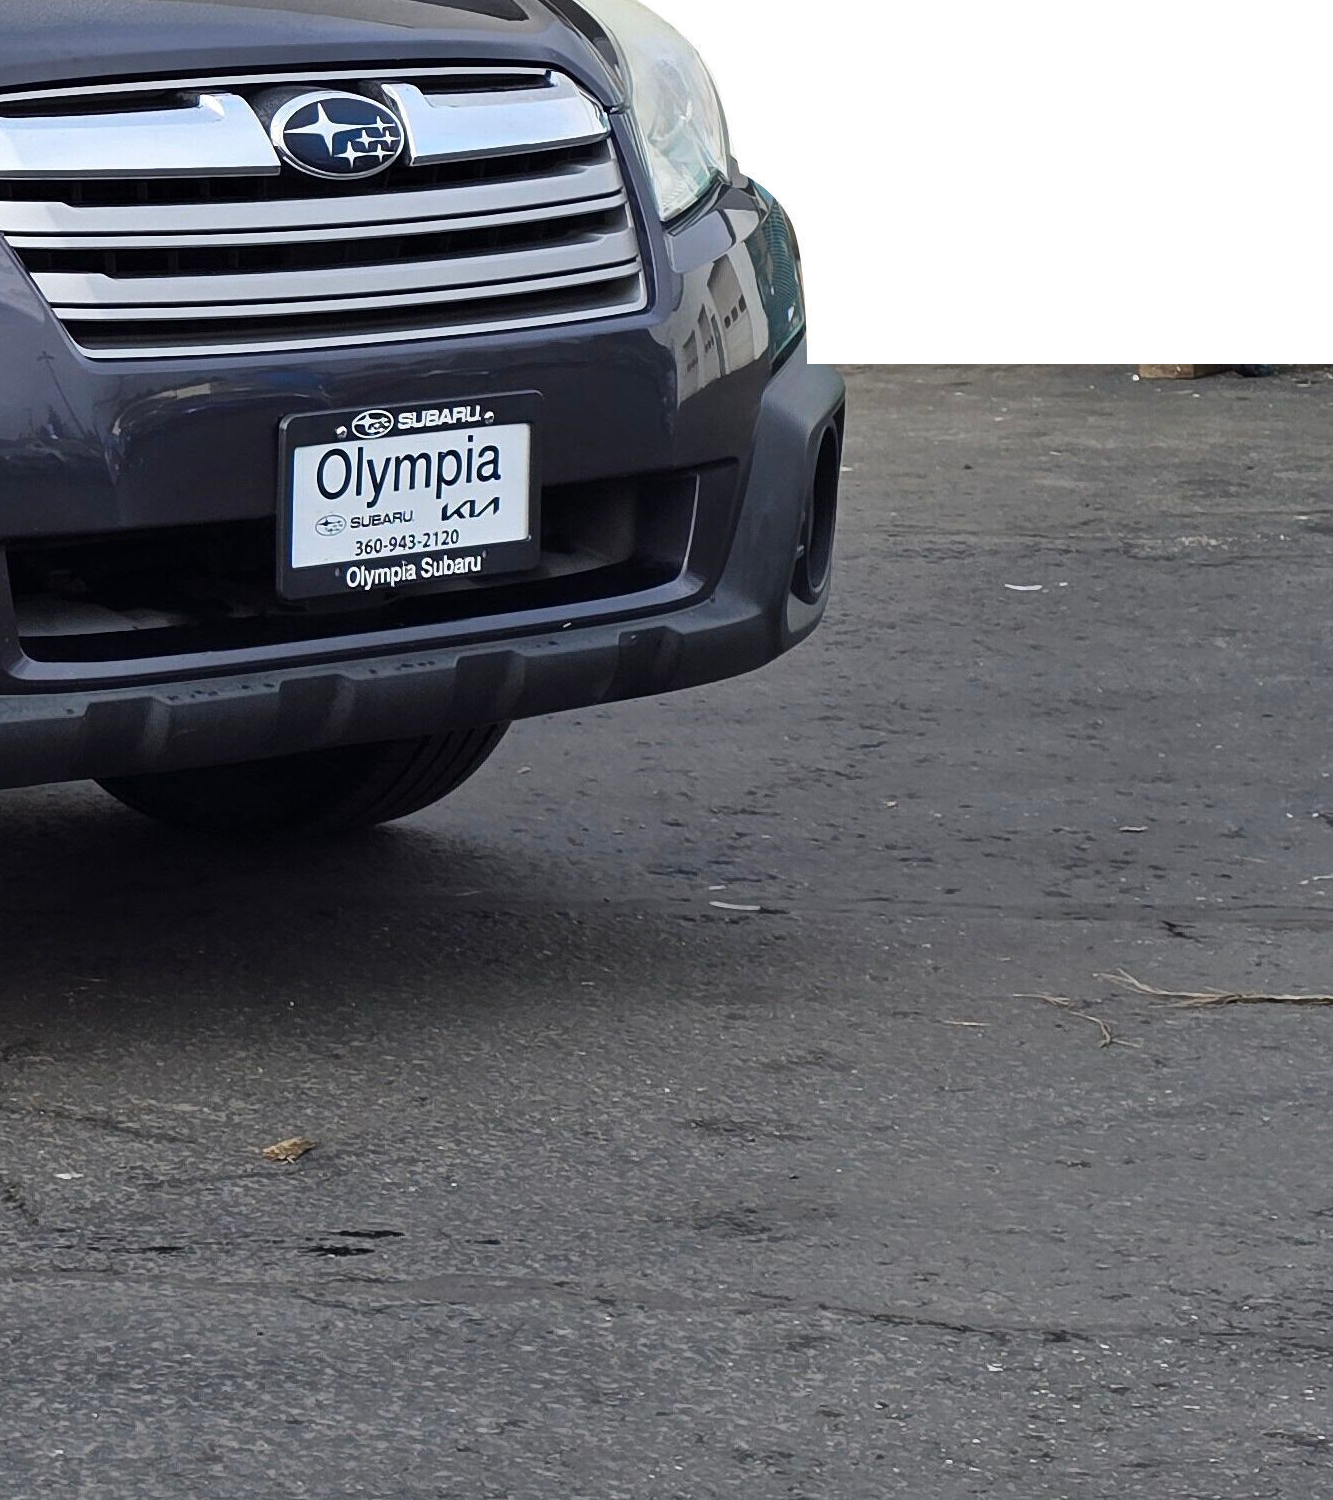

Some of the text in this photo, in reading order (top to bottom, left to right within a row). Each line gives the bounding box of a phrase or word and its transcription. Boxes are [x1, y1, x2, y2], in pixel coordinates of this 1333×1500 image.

[315, 435, 502, 509] Olympia
[354, 528, 460, 557] 360-943-2120
[345, 555, 482, 591] Olympia Subaru
